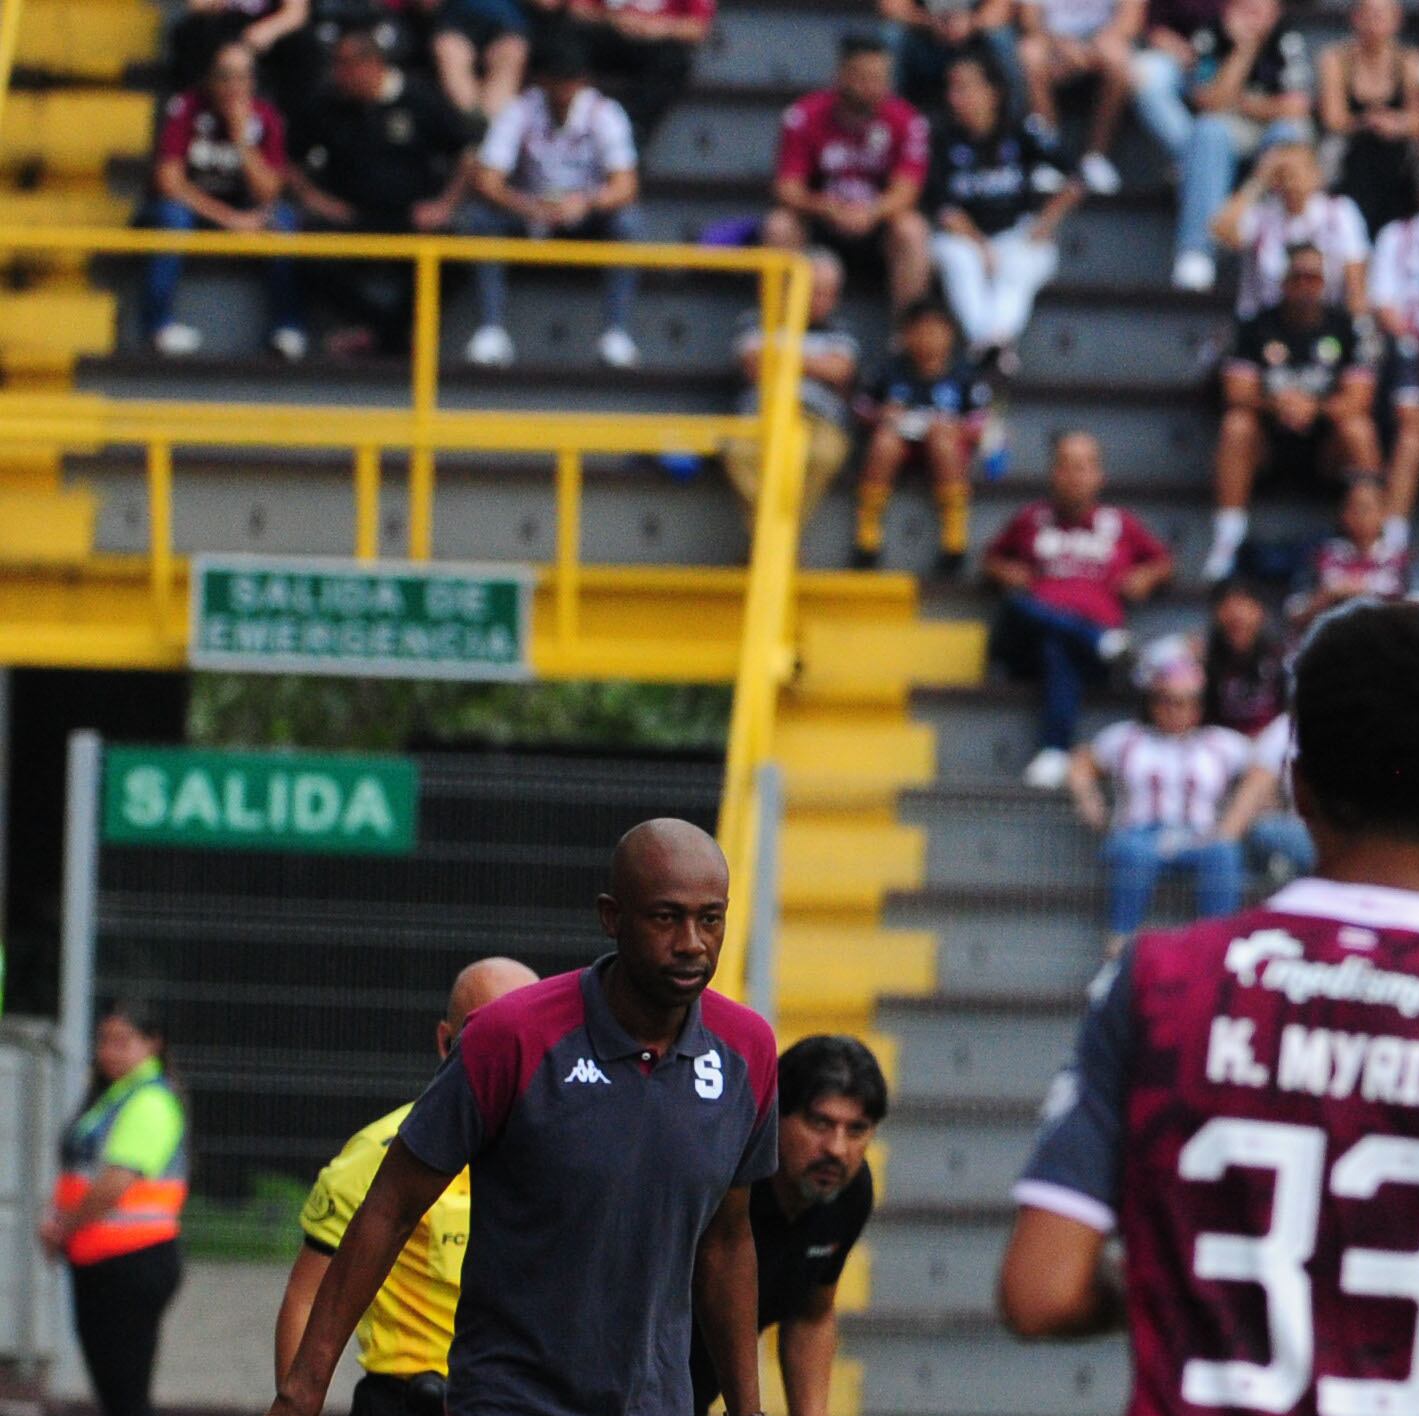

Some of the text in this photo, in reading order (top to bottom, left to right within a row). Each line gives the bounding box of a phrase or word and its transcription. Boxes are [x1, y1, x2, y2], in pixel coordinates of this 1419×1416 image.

[230, 577, 488, 617] SALIDA DE
[207, 616, 512, 660] EMERGENCIA
[122, 766, 395, 837] SALIDA
[694, 1050, 724, 1099] S
[1206, 1015, 1270, 1088] K.
